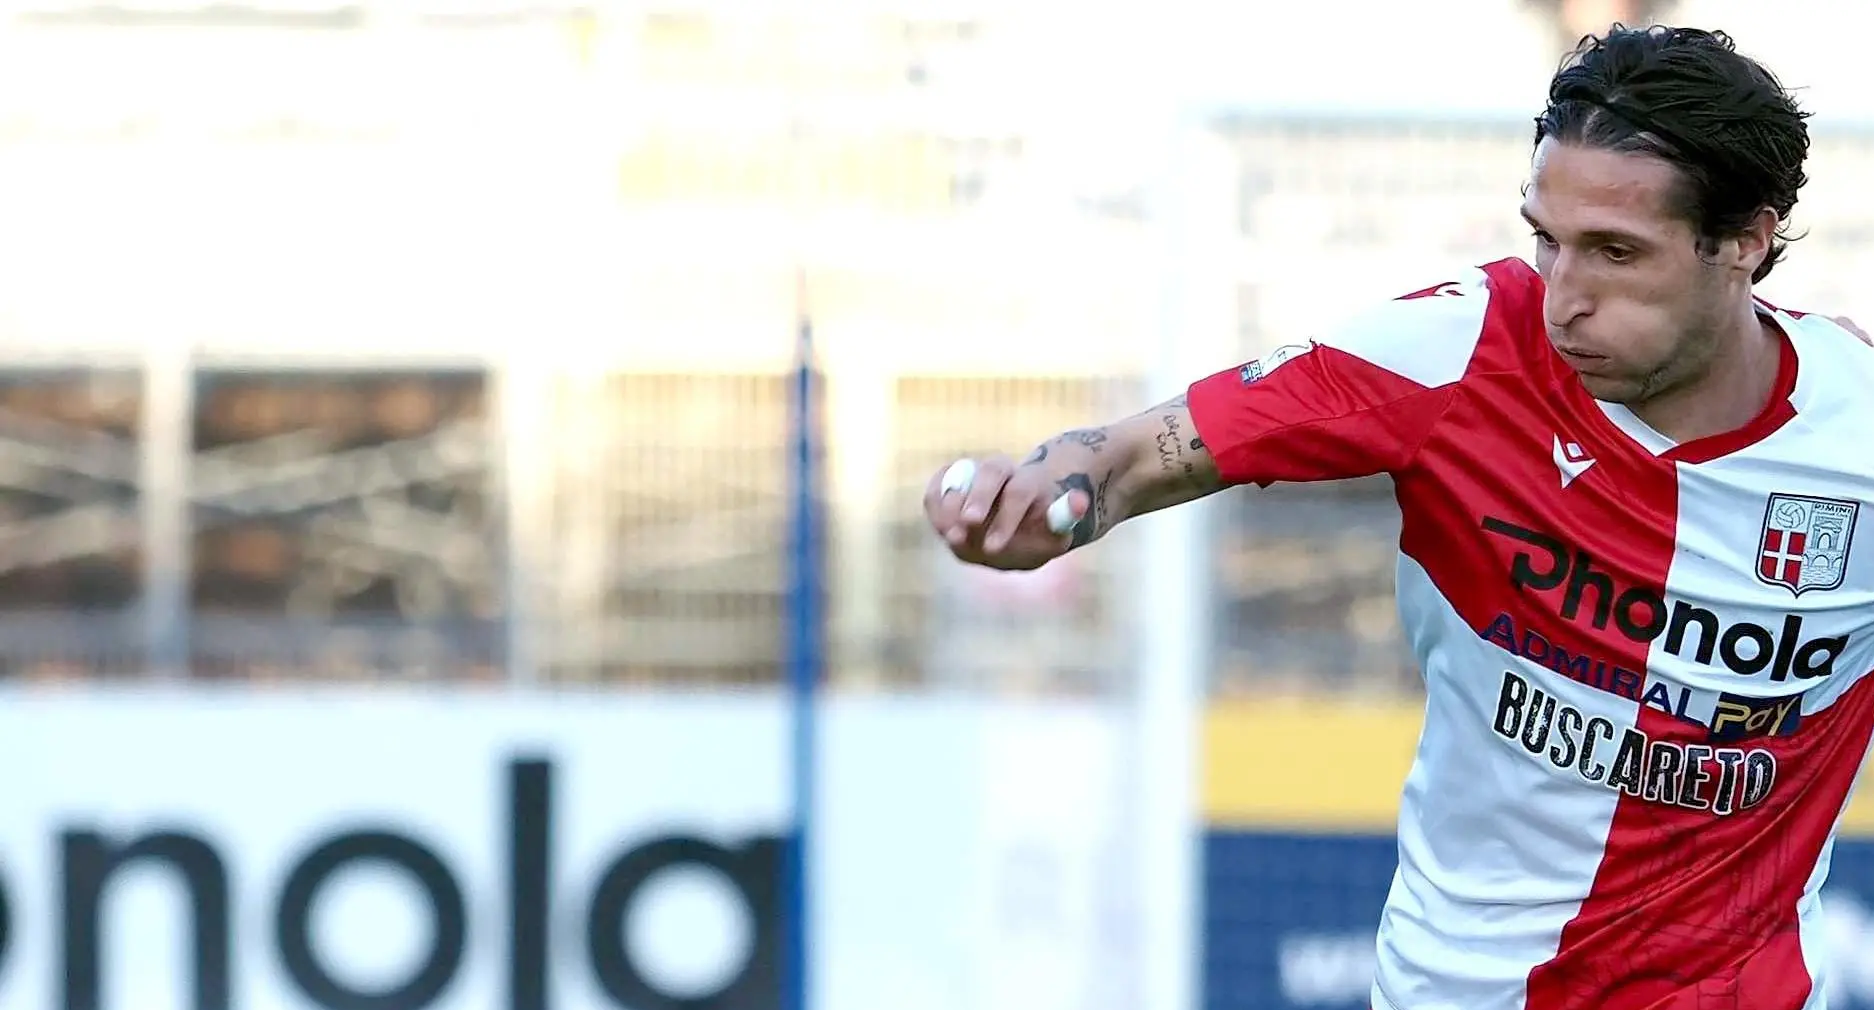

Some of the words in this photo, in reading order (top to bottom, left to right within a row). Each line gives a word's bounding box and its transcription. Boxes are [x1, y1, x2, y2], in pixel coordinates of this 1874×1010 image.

[1479, 610, 1709, 726] ADMIRAL
[1480, 515, 1851, 682] Phonola
[1493, 669, 1777, 815] BUSCARETO
